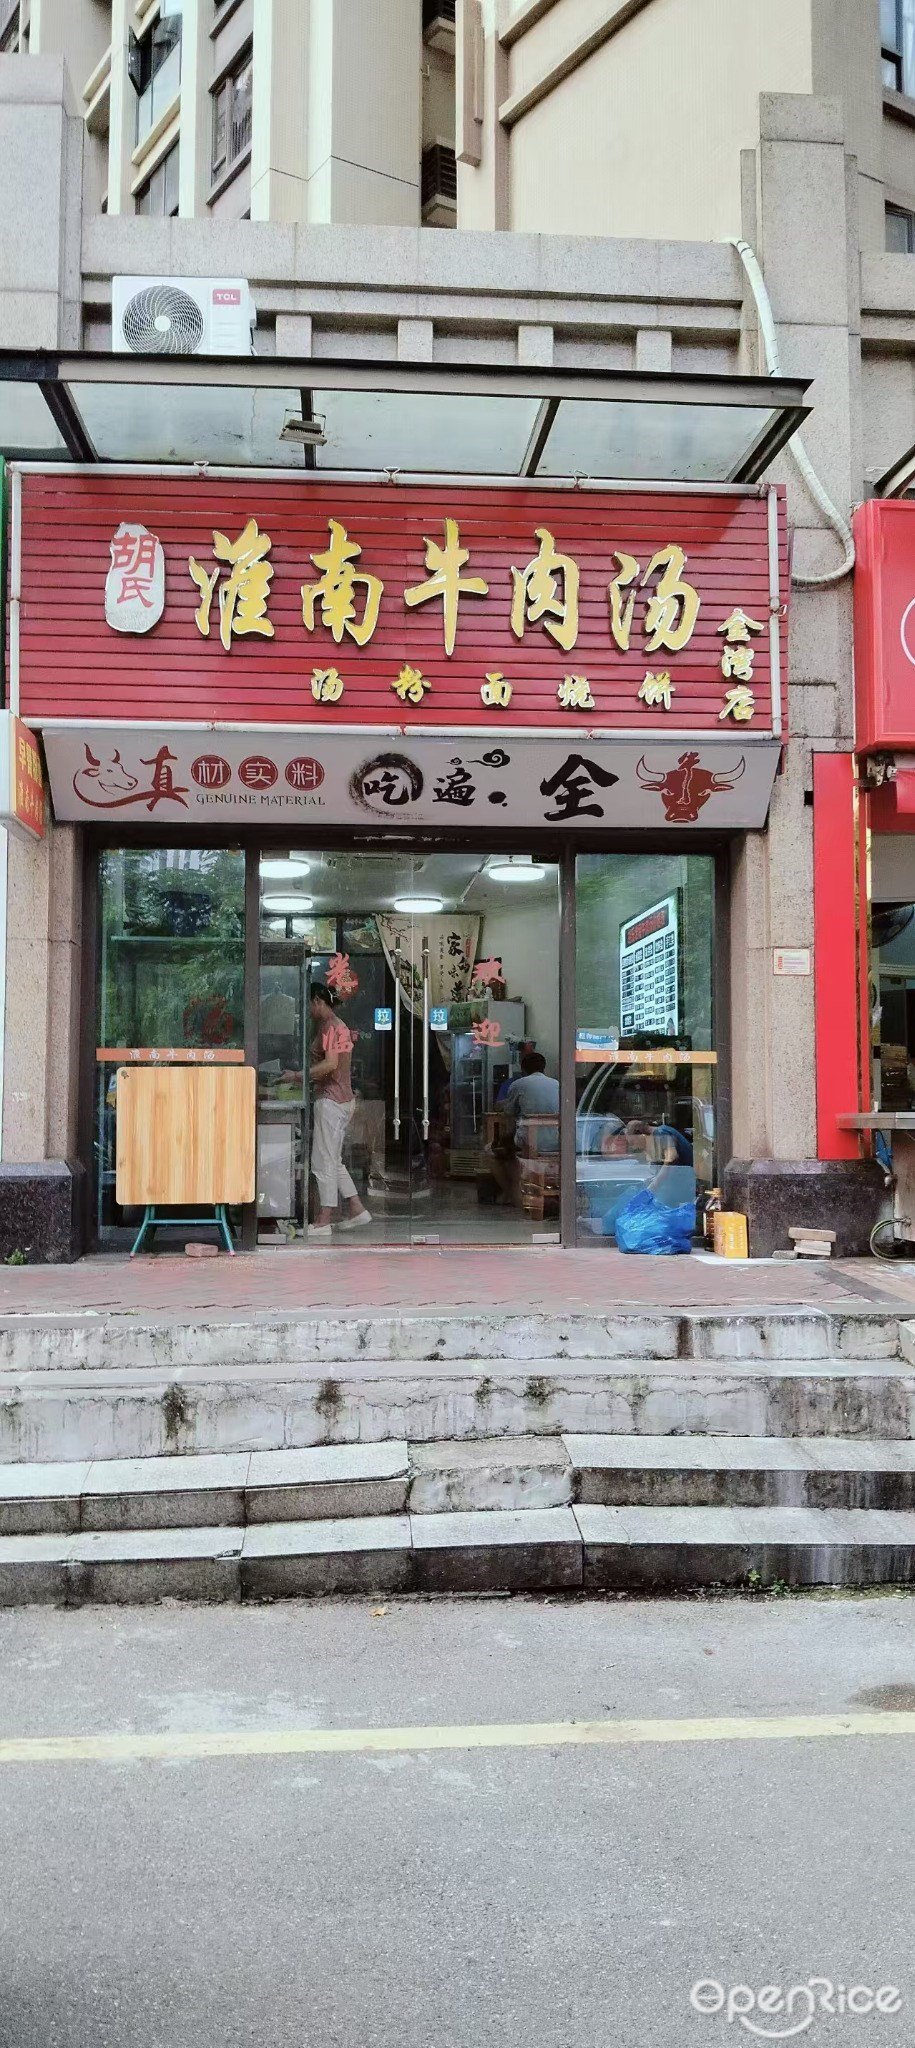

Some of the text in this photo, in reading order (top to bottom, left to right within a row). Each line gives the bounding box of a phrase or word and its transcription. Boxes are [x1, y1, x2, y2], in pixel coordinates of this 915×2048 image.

[216, 292, 237, 301] TCL
[110, 533, 159, 608] 胡氏
[189, 516, 701, 657] 淮南牛肉汤
[716, 607, 764, 722] 金湾店
[196, 793, 326, 807] GENUINE MATERIAL
